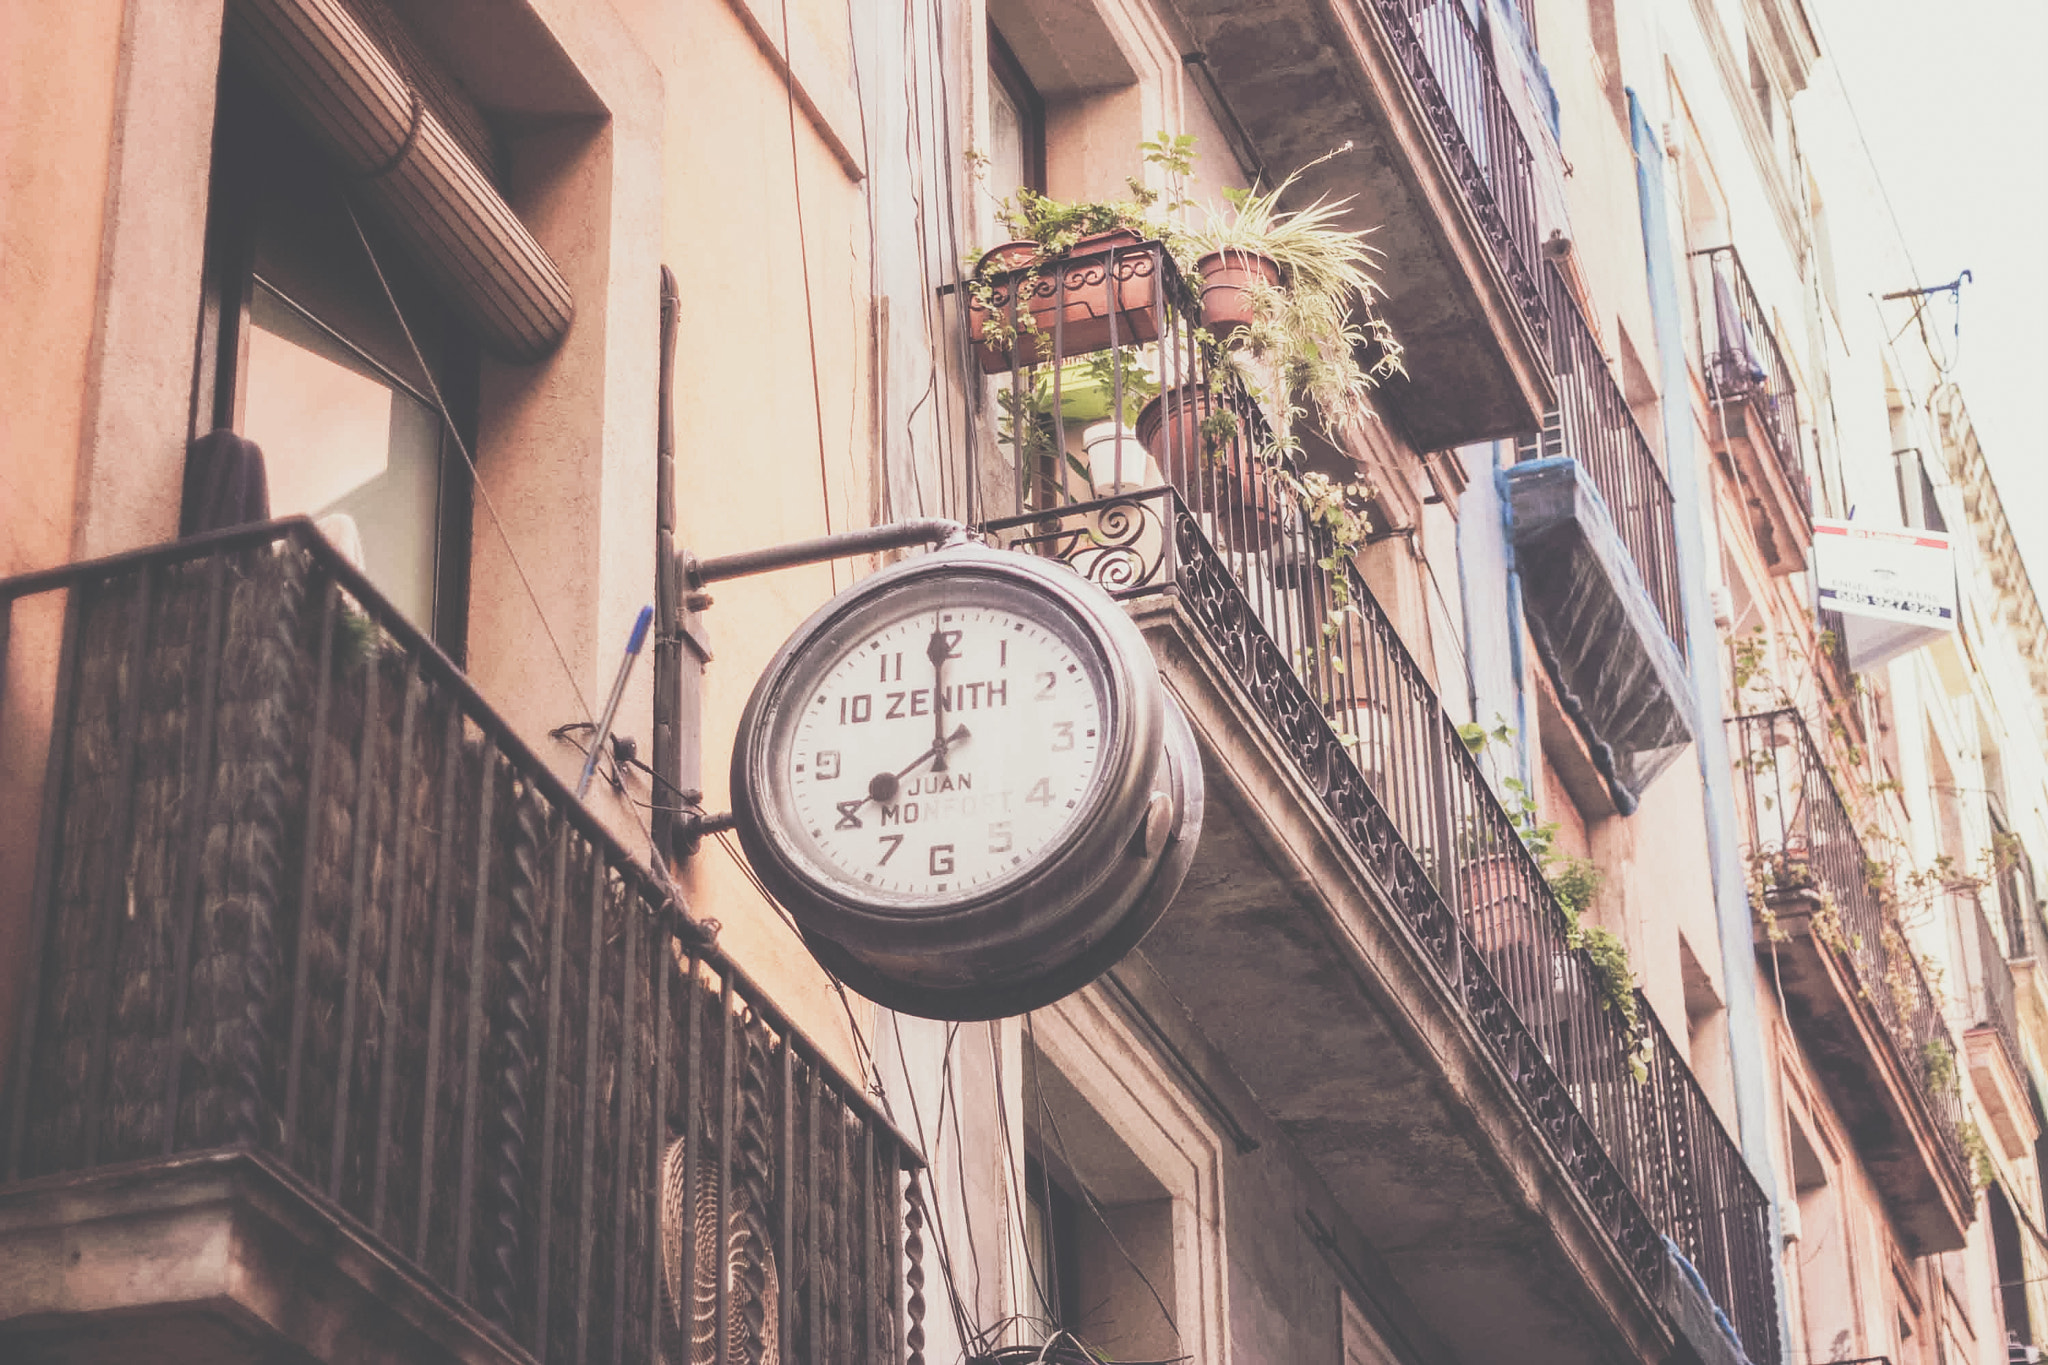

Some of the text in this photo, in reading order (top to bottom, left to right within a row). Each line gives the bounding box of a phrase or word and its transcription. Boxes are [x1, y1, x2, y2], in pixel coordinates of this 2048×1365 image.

[930, 629, 963, 660] 2
[999, 639, 1008, 667] 1
[879, 652, 903, 682] 11
[885, 679, 1008, 719] ZENITH
[1033, 671, 1057, 703] 2
[838, 693, 872, 725] 10
[1051, 720, 1075, 752] 3
[815, 750, 841, 780] 9
[907, 772, 973, 797] JUAN
[1024, 777, 1056, 808] 4
[834, 799, 864, 831] 8
[878, 834, 904, 866] 7
[988, 820, 1013, 854] 5
